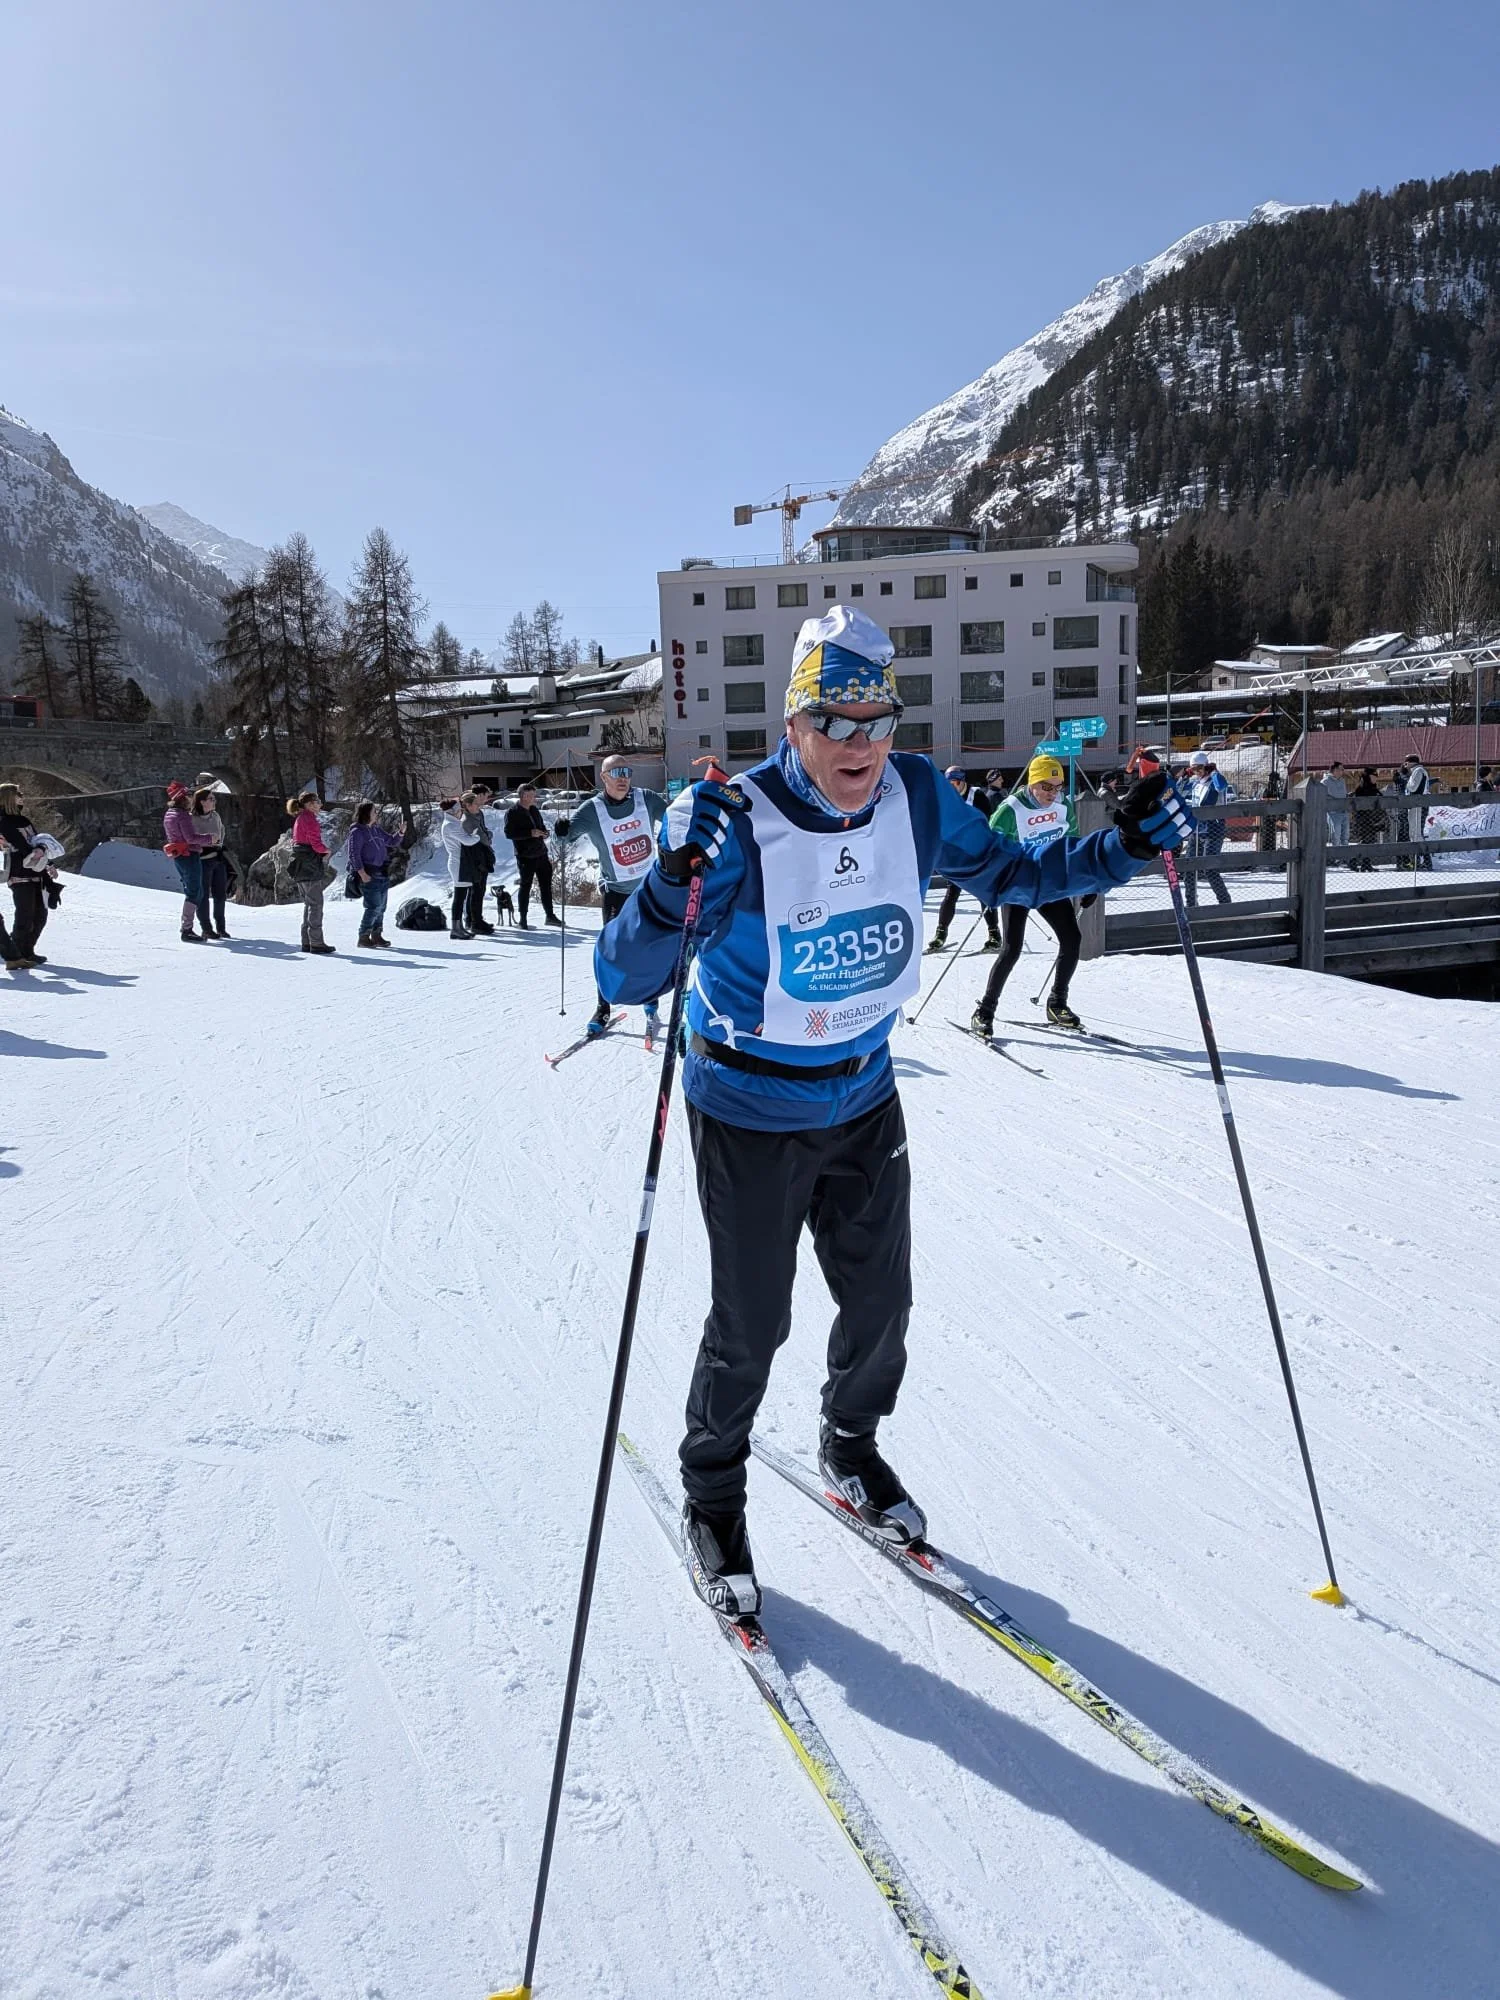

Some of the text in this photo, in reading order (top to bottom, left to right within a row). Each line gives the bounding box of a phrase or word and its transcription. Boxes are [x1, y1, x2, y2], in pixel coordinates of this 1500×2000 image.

[612, 819, 641, 834] coop
[1027, 811, 1058, 825] coop
[618, 839, 647, 857] 19013
[829, 874, 866, 889] odlo
[796, 906, 823, 925] C23
[792, 919, 904, 975] 23358
[819, 983, 850, 991] ENGADIN
[832, 1002, 882, 1023] ENGADIN
[831, 1013, 881, 1031] SKIMARATHON
[835, 1507, 911, 1565] FISCHER
